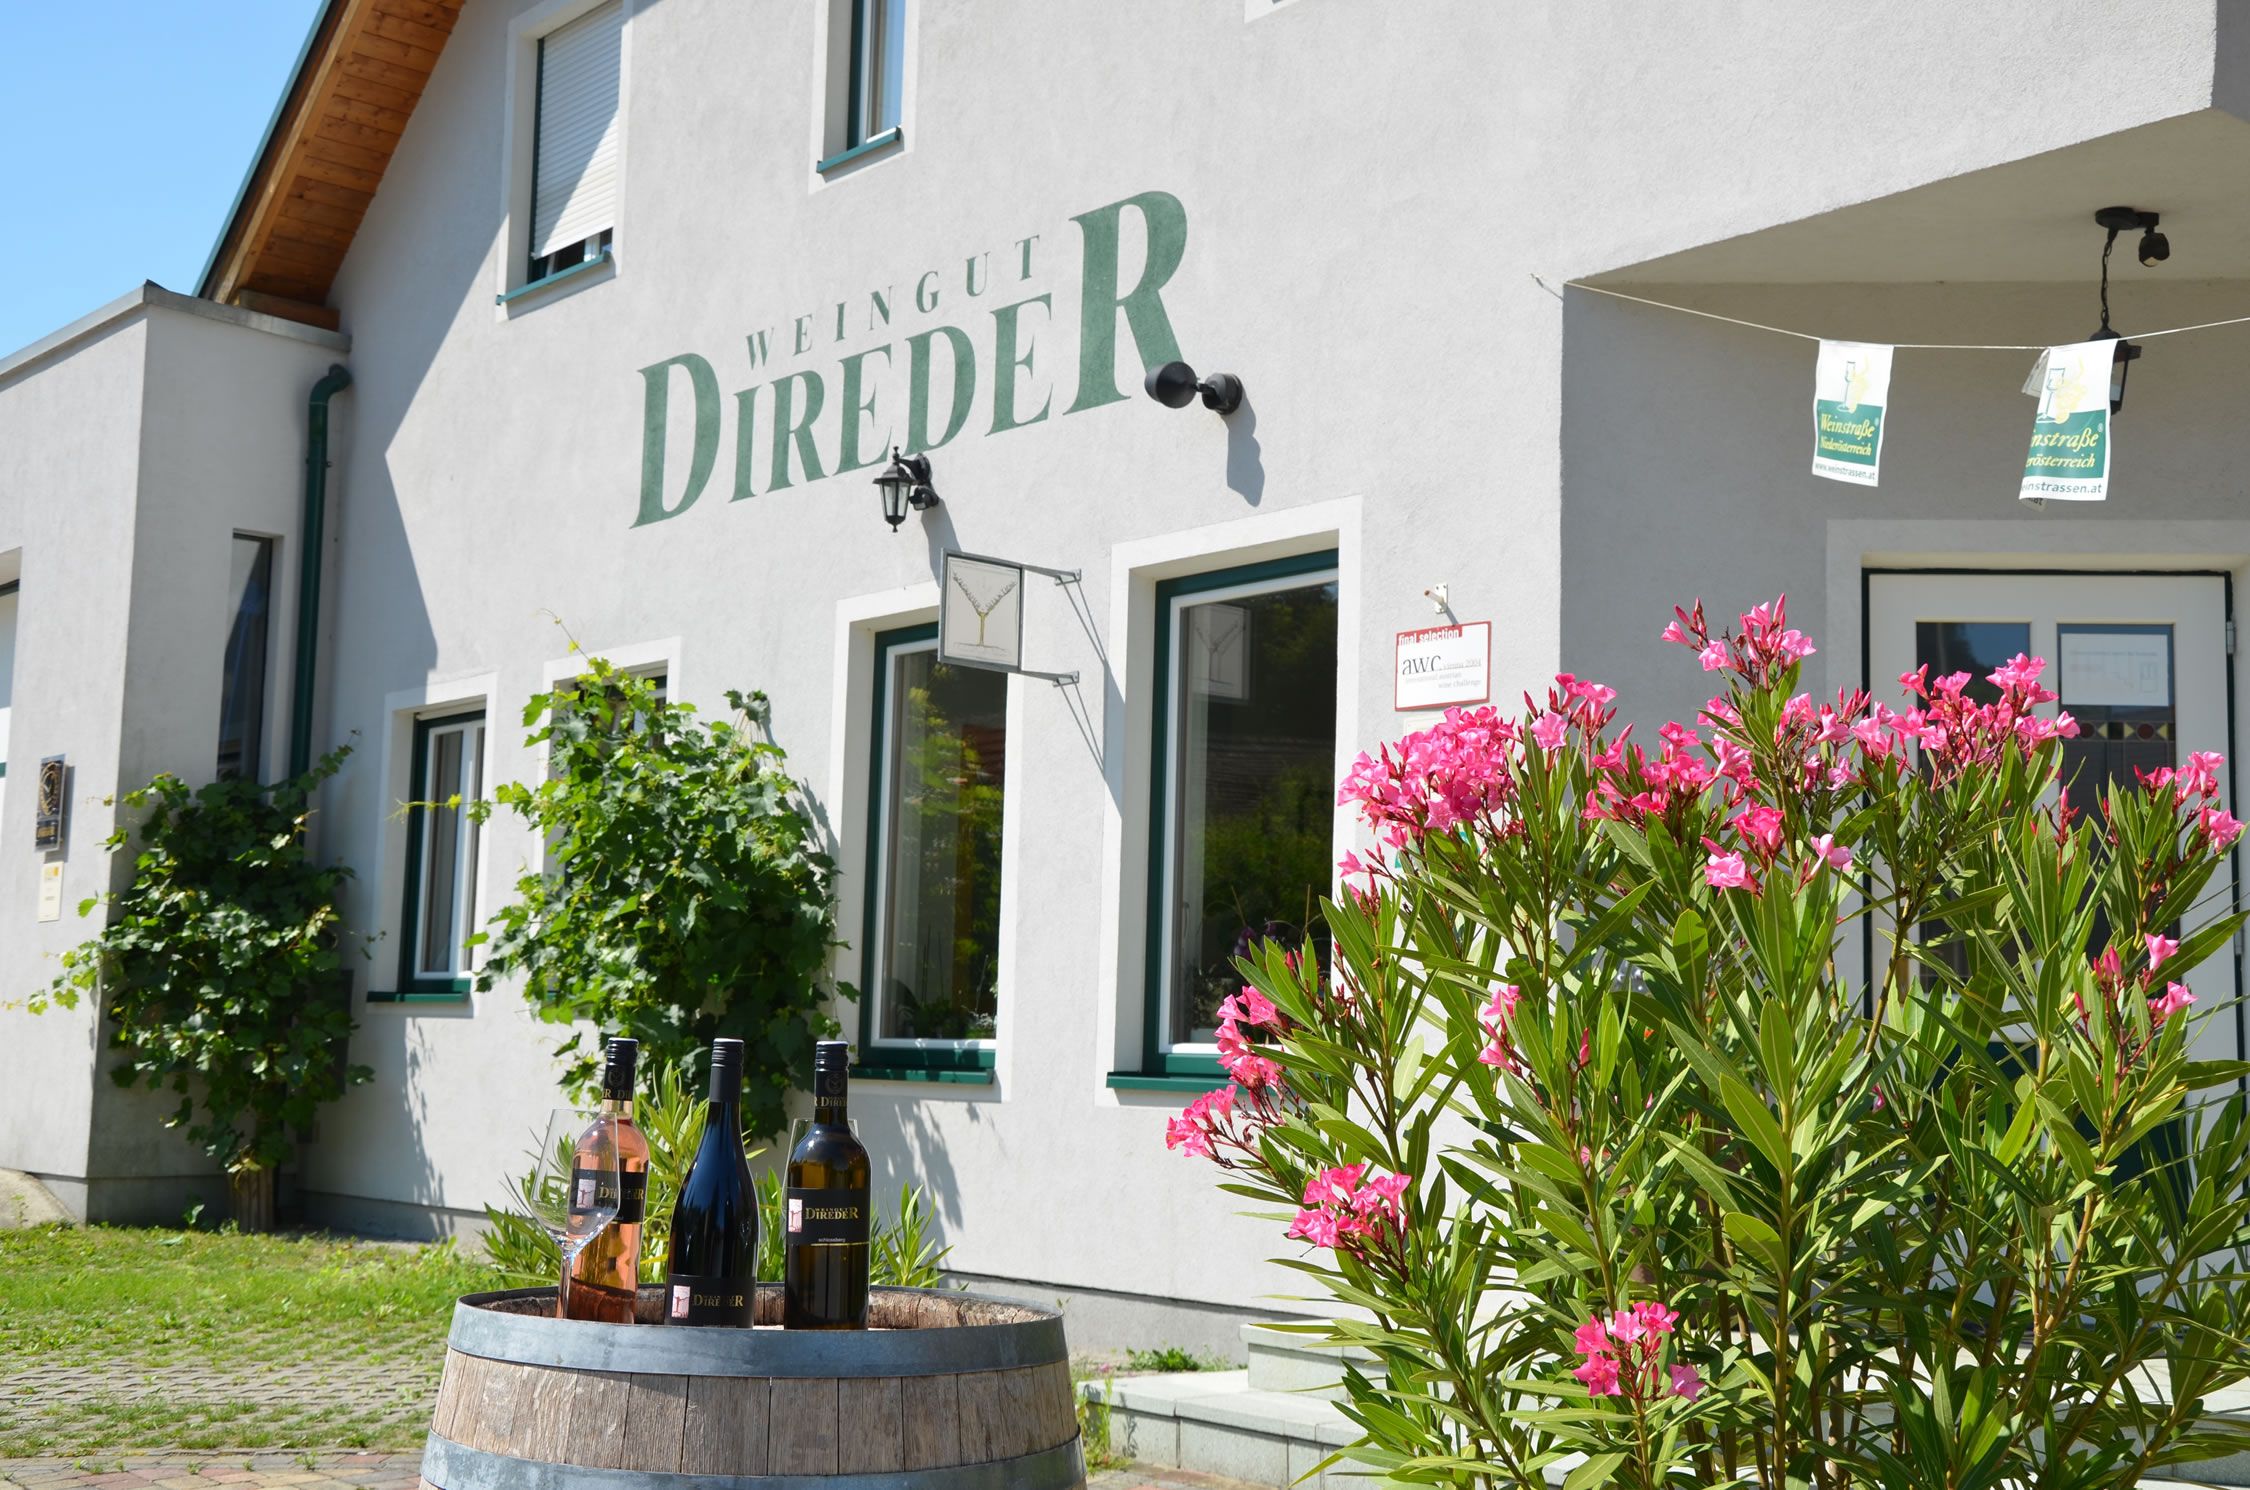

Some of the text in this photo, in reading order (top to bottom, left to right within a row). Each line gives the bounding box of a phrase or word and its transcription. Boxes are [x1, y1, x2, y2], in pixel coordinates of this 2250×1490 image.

[746, 234, 1041, 371] WEINGUT
[629, 190, 1188, 529] DIREDER
[1820, 413, 1876, 440] Weinstraße
[1419, 628, 1459, 641] selection
[1402, 655, 1442, 676] awc
[805, 1207, 859, 1220] DIREDER
